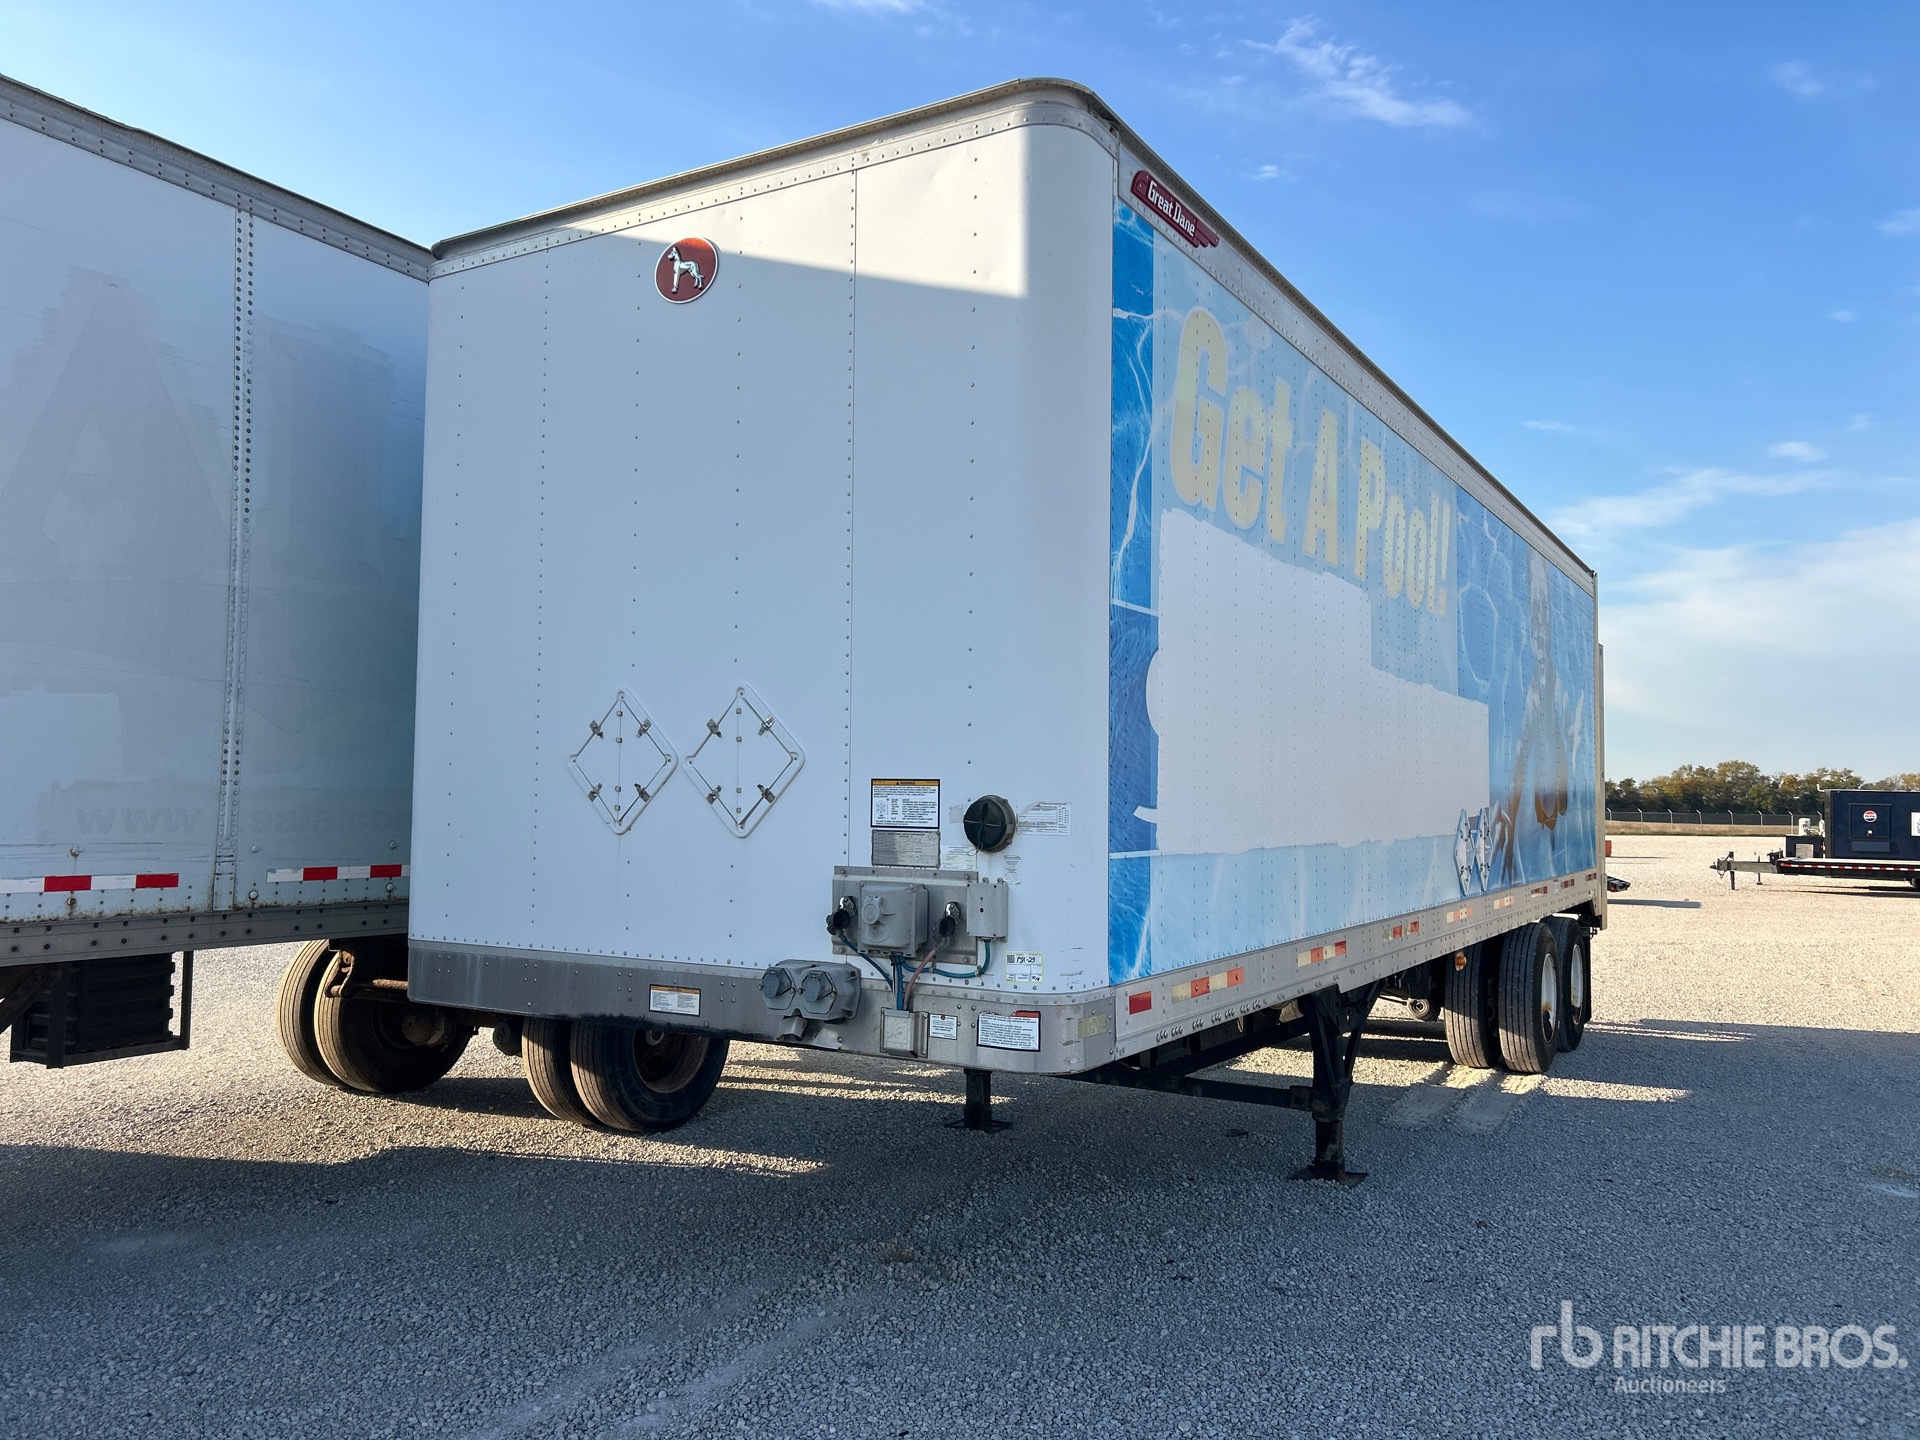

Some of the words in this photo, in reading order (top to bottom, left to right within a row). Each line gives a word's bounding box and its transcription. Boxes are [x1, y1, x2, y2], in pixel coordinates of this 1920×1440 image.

[1147, 180, 1174, 217] Great
[1172, 201, 1195, 237] Dane
[1170, 306, 1293, 544] Get
[1303, 407, 1338, 567] A
[1355, 436, 1452, 616] Pool!
